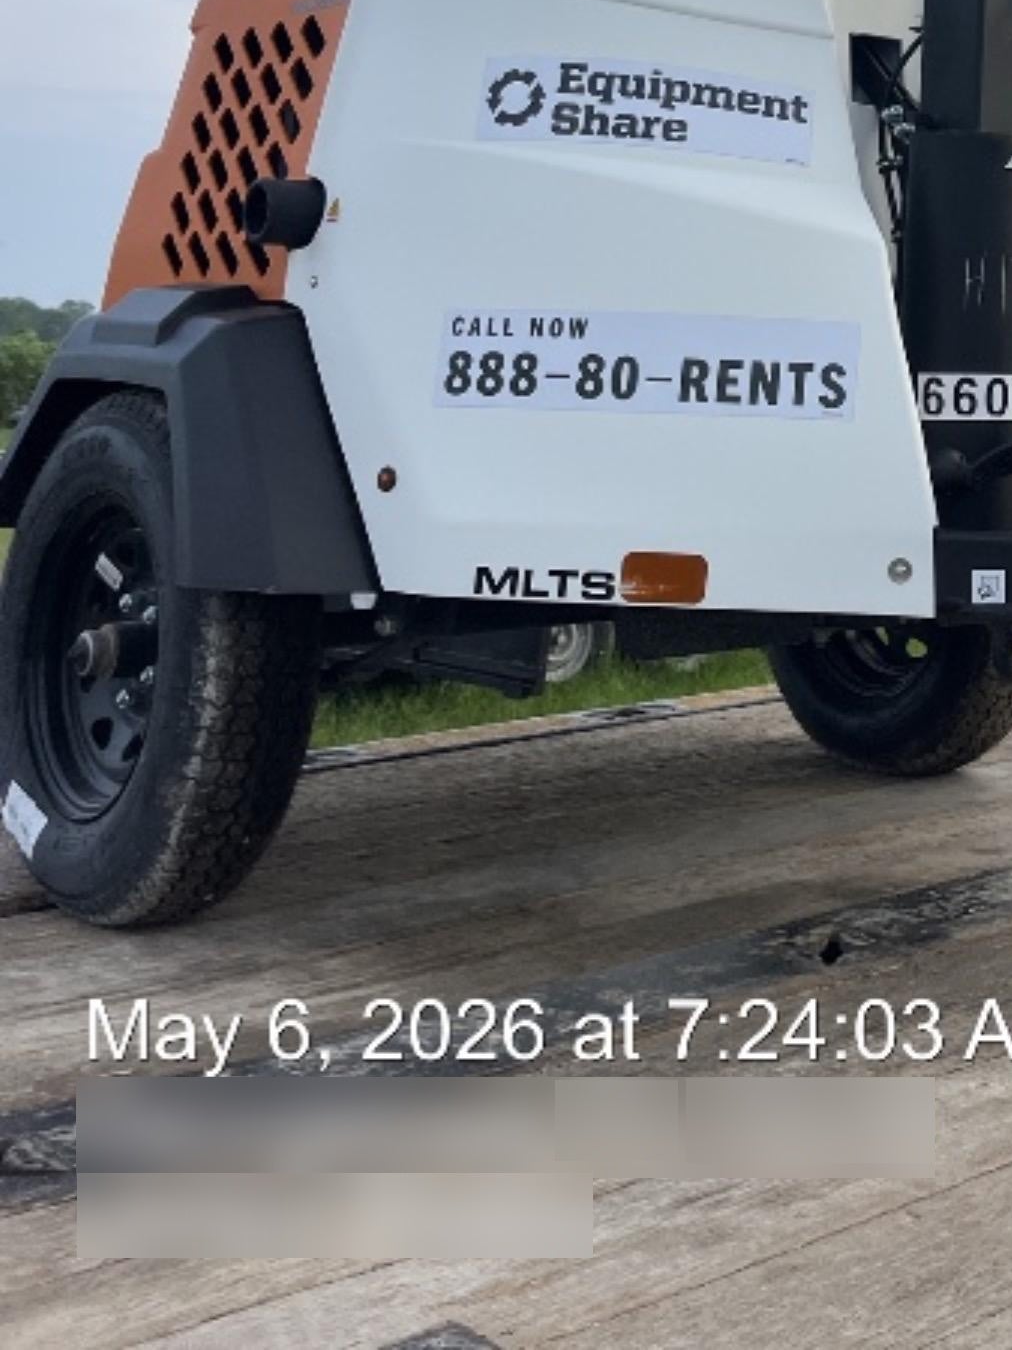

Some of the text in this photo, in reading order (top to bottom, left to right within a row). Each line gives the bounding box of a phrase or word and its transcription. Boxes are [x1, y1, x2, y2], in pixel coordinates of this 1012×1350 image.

[557, 62, 808, 123] Equipment
[551, 102, 688, 141] Share
[452, 316, 589, 339] CALL NOW
[444, 350, 847, 409] 888-80-RENTS
[473, 566, 615, 600] MLTS
